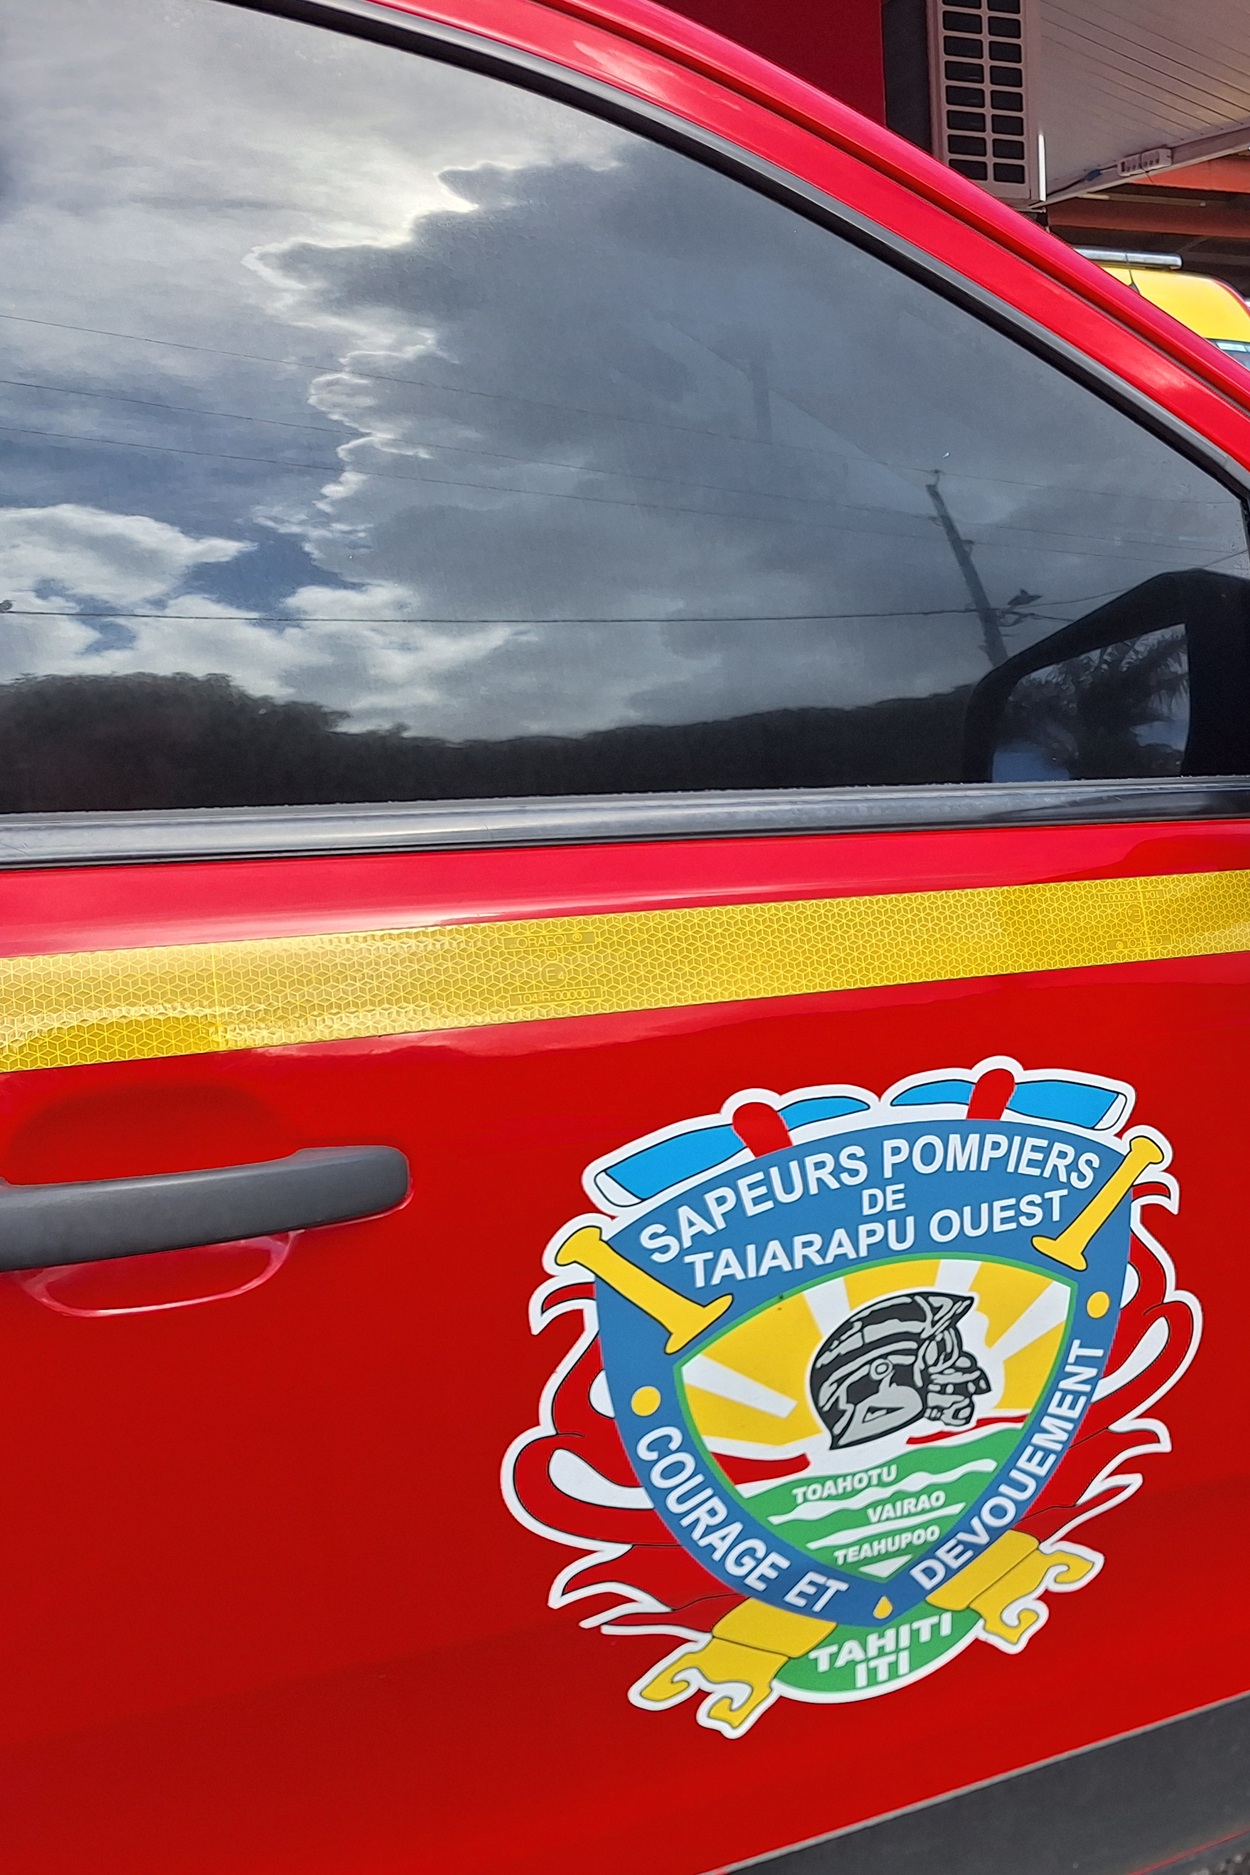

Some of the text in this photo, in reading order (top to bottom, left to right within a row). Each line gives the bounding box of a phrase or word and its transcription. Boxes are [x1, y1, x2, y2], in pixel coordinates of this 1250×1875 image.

[639, 1133, 1100, 1264] SAPEURS POMPIERS
[861, 1184, 906, 1216] DE
[684, 1189, 1069, 1288] TAIARAPU OUEST
[635, 1338, 1104, 1613] COURAGE ET DEVOUEMENT
[792, 1463, 899, 1504] TOAHOTU
[865, 1490, 946, 1523] VAIRAO
[833, 1525, 941, 1566] TEAHUPOO
[808, 1612, 953, 1672] TAHITI
[854, 1651, 912, 1690] ITI
